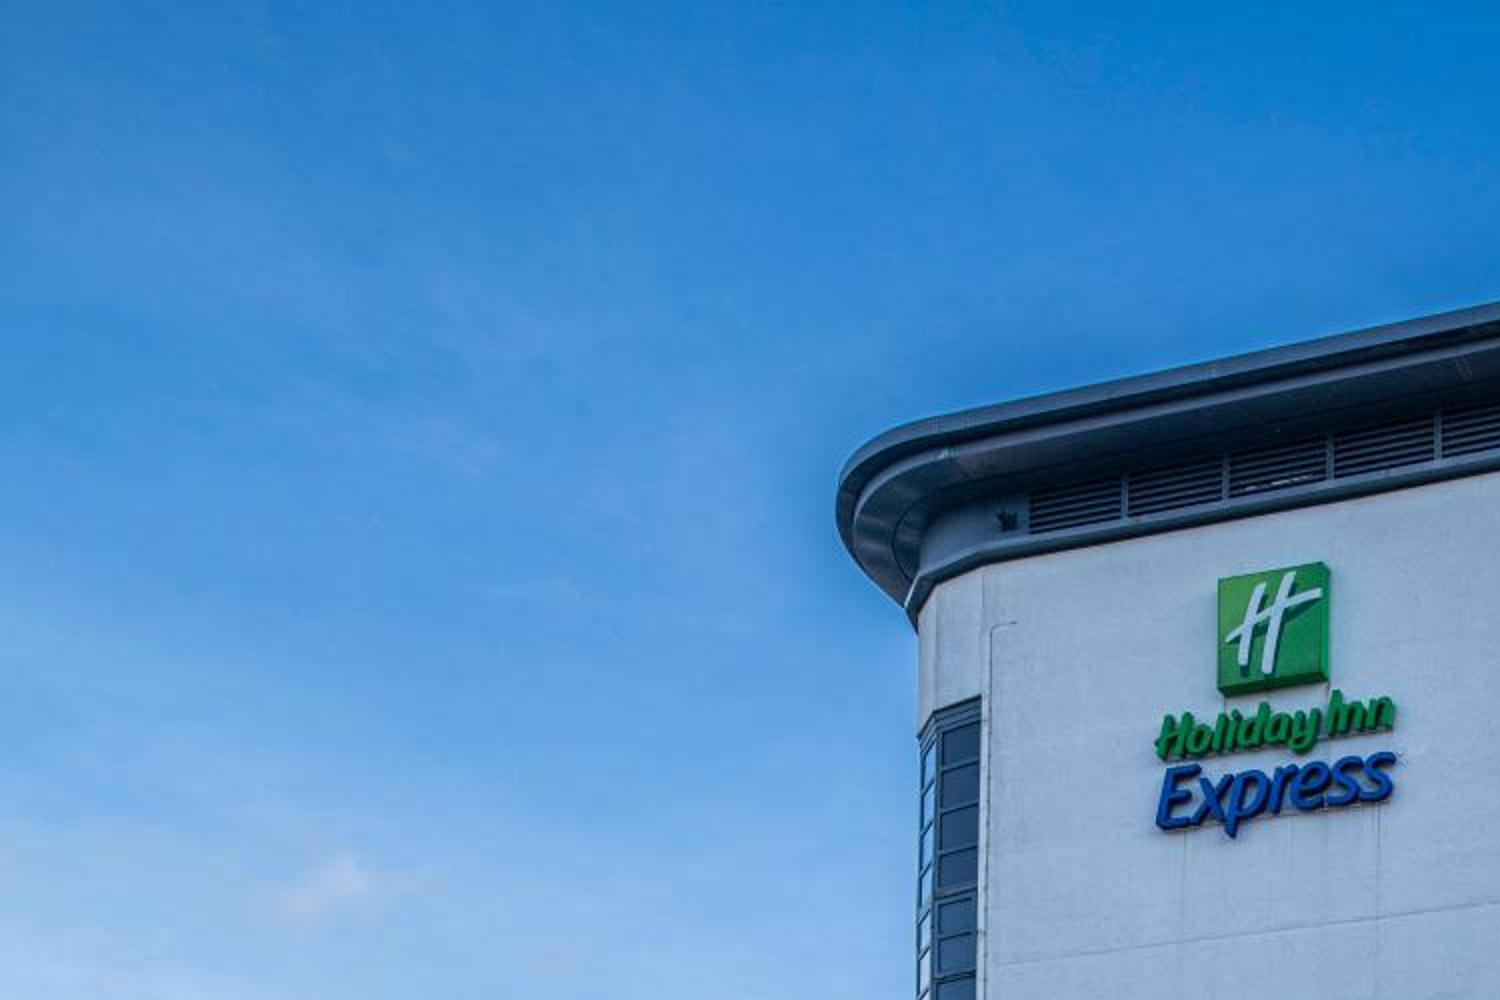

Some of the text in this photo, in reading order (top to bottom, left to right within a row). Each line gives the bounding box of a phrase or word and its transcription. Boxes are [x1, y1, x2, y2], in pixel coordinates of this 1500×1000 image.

[1154, 689, 1395, 761] Holiday Inn
[1155, 751, 1397, 838] Express
